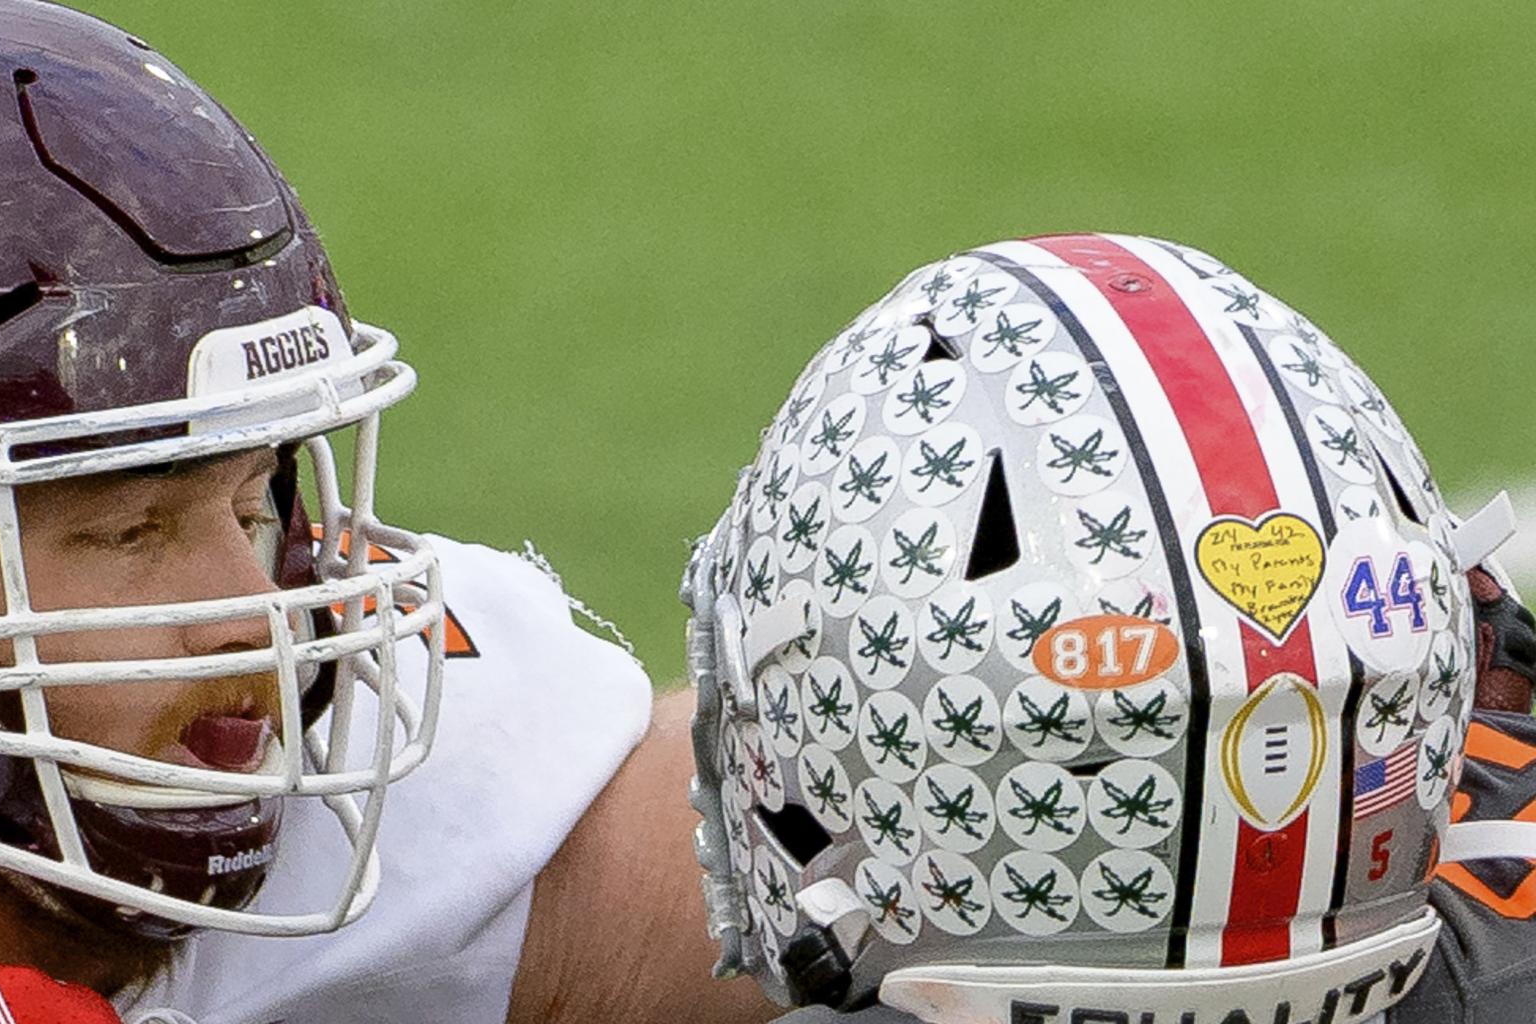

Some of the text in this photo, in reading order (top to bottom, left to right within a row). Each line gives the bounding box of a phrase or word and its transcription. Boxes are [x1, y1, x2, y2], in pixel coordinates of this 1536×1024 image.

[240, 323, 331, 381] AGGIES
[1340, 550, 1429, 640] 44
[1050, 621, 1159, 679] 817
[1366, 828, 1394, 882] 5
